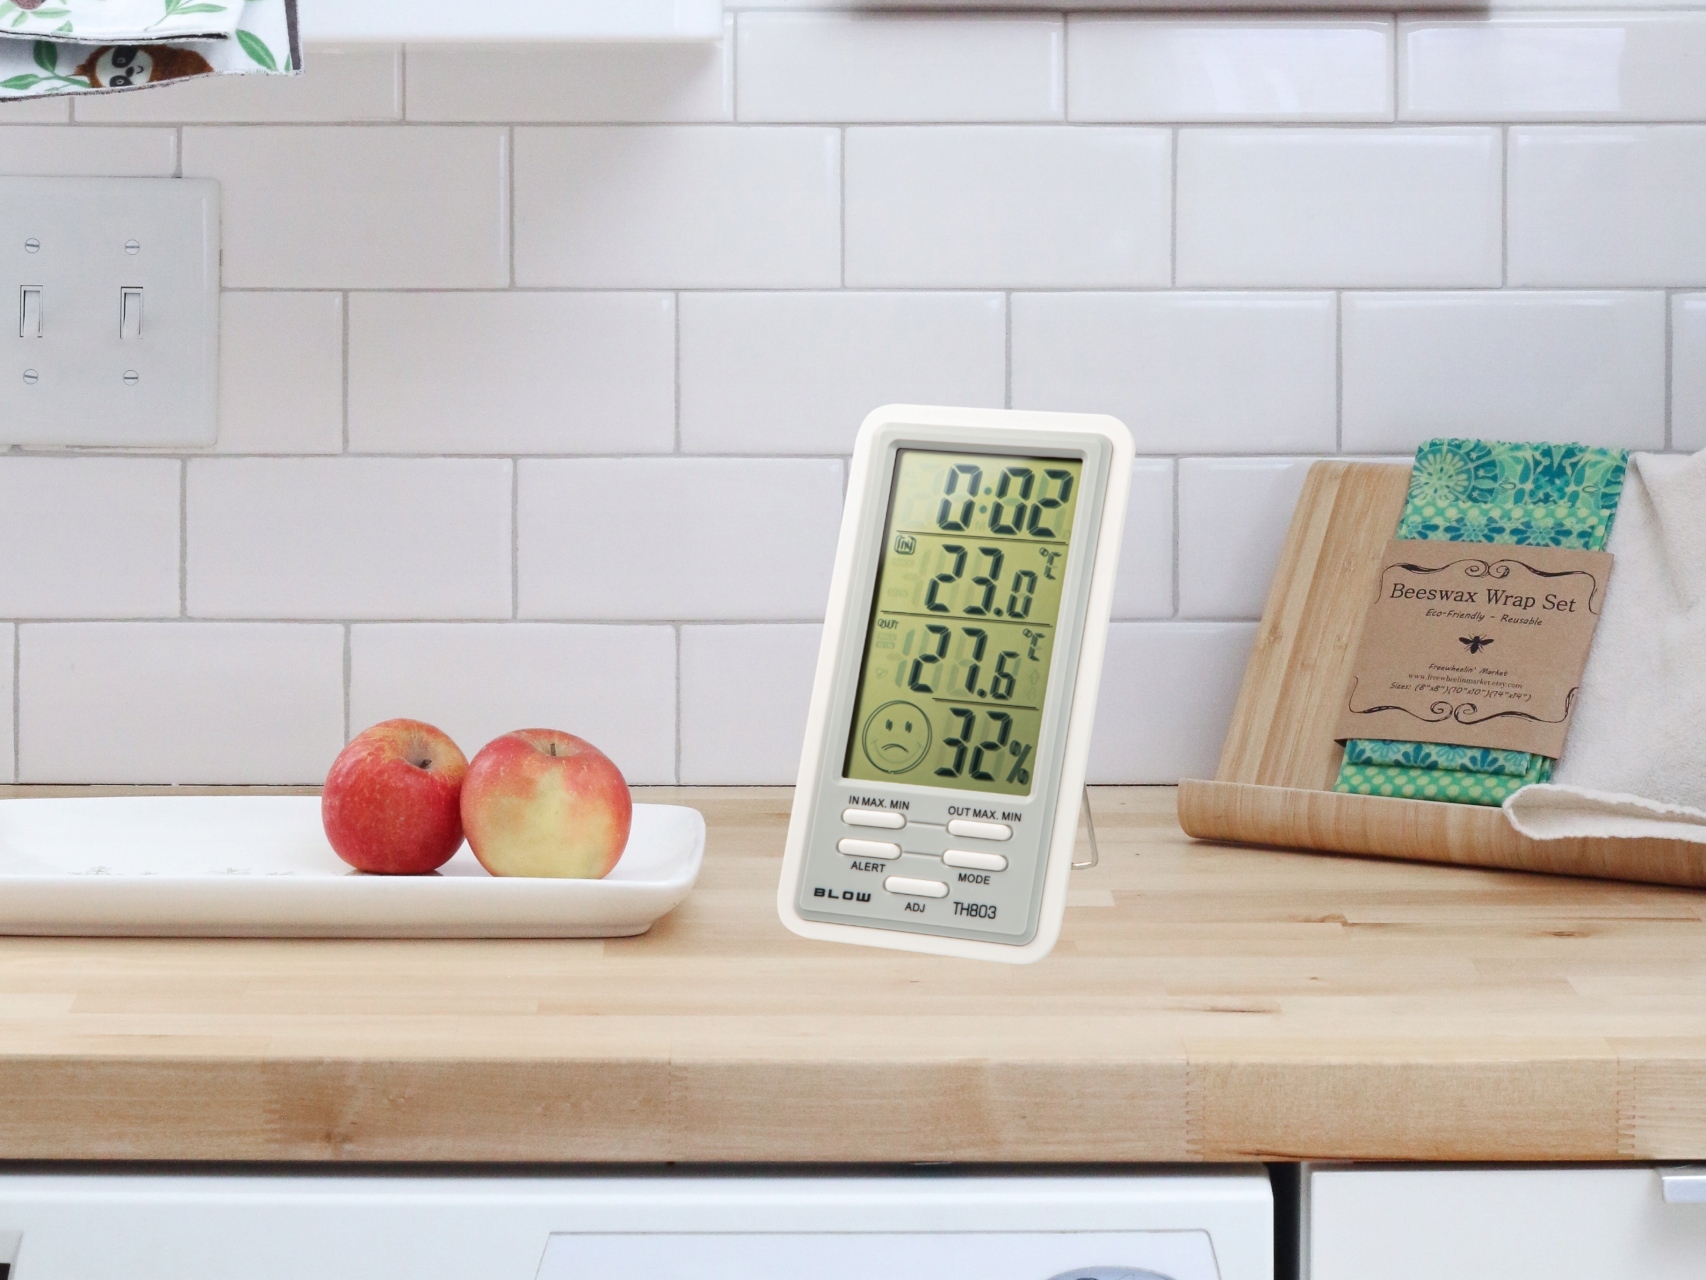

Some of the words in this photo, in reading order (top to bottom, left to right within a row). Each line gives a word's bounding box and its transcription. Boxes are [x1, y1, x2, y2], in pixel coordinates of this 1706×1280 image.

[936, 463, 1074, 538] 0:02
[924, 544, 1038, 619] 23.0
[1389, 582, 1478, 603] Beeswax
[1486, 588, 1536, 610] Wrap
[1542, 593, 1577, 613] Set
[878, 619, 899, 629] OUT
[1425, 608, 1485, 621] Eco-Friendly
[1500, 614, 1543, 626] Reusable
[908, 624, 1021, 700] 27.6
[1428, 663, 1477, 673] Freewheelin'
[1479, 667, 1508, 677] Market
[849, 796, 860, 805] IN
[861, 797, 887, 808] MAX.
[890, 800, 910, 810] MIN
[948, 806, 971, 817] OUT
[972, 808, 999, 820] MAX.
[1001, 811, 1022, 822] MIN
[850, 860, 886, 873] ALERT
[957, 873, 991, 885] MODE
[813, 887, 872, 903] BLOW
[904, 902, 925, 913] ADJ
[952, 901, 997, 919] TH803
